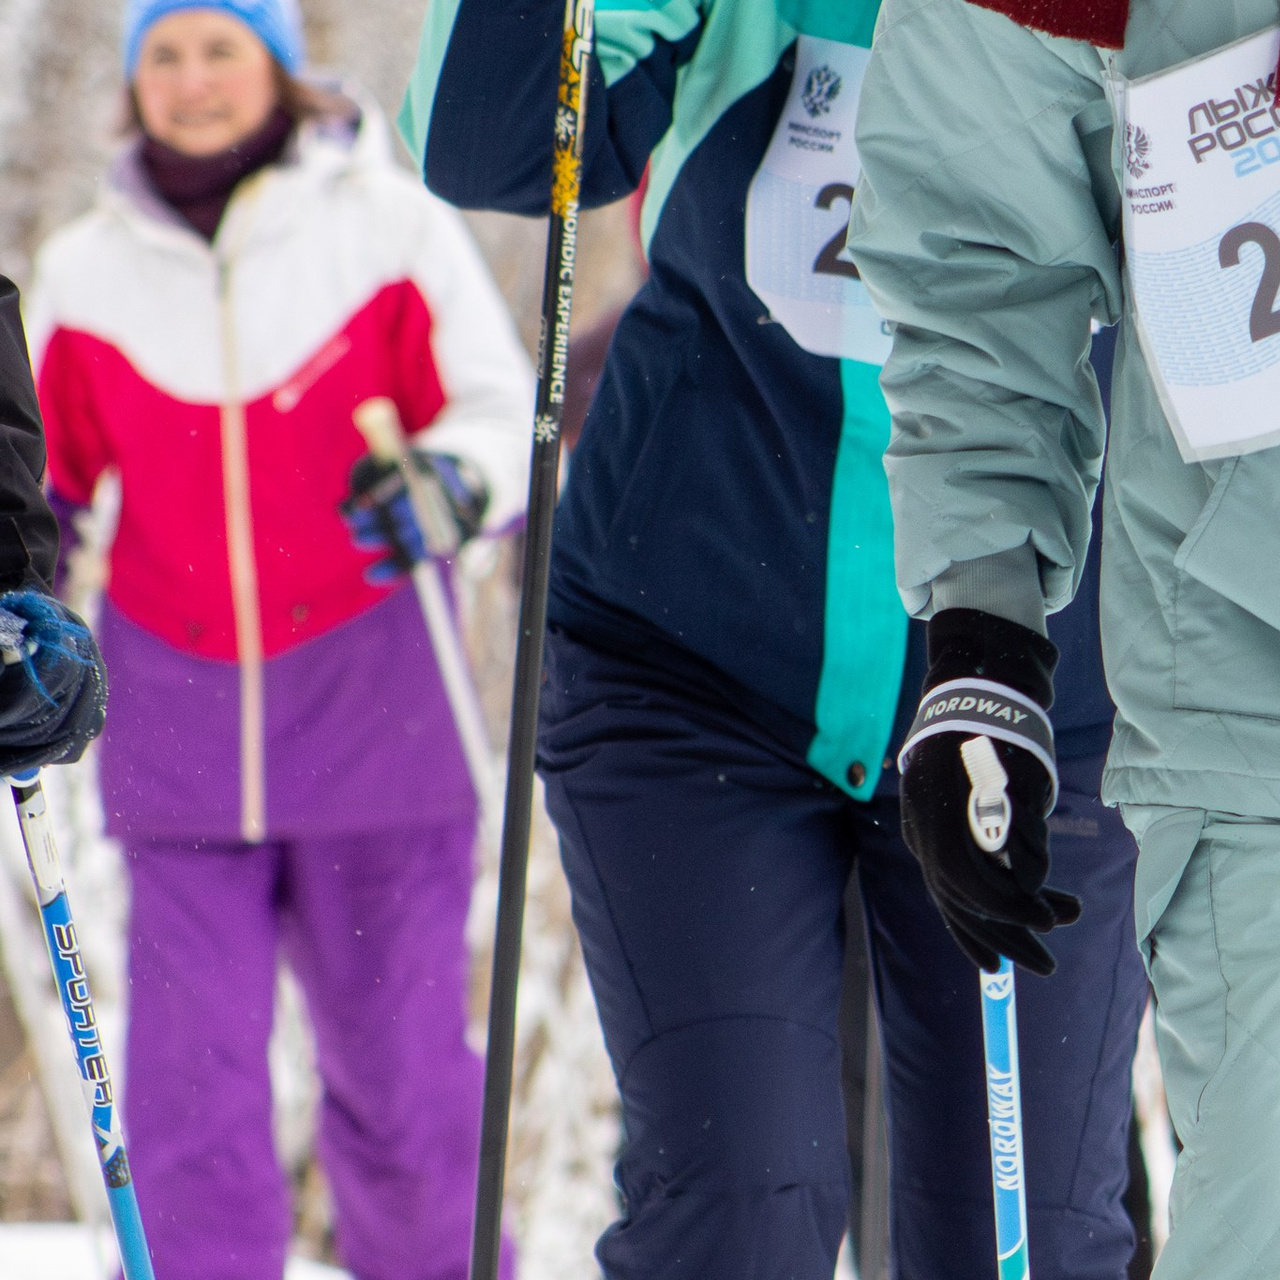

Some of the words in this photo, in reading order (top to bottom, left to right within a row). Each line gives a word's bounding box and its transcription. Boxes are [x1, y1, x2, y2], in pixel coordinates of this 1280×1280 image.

[1187, 72, 1278, 135] ЛЫЖ
[559, 201, 580, 279] NORDIC
[549, 284, 573, 404] EXPERIENCE
[923, 696, 1029, 725] NORDWAY
[988, 1063, 1021, 1191] NORDWAY
